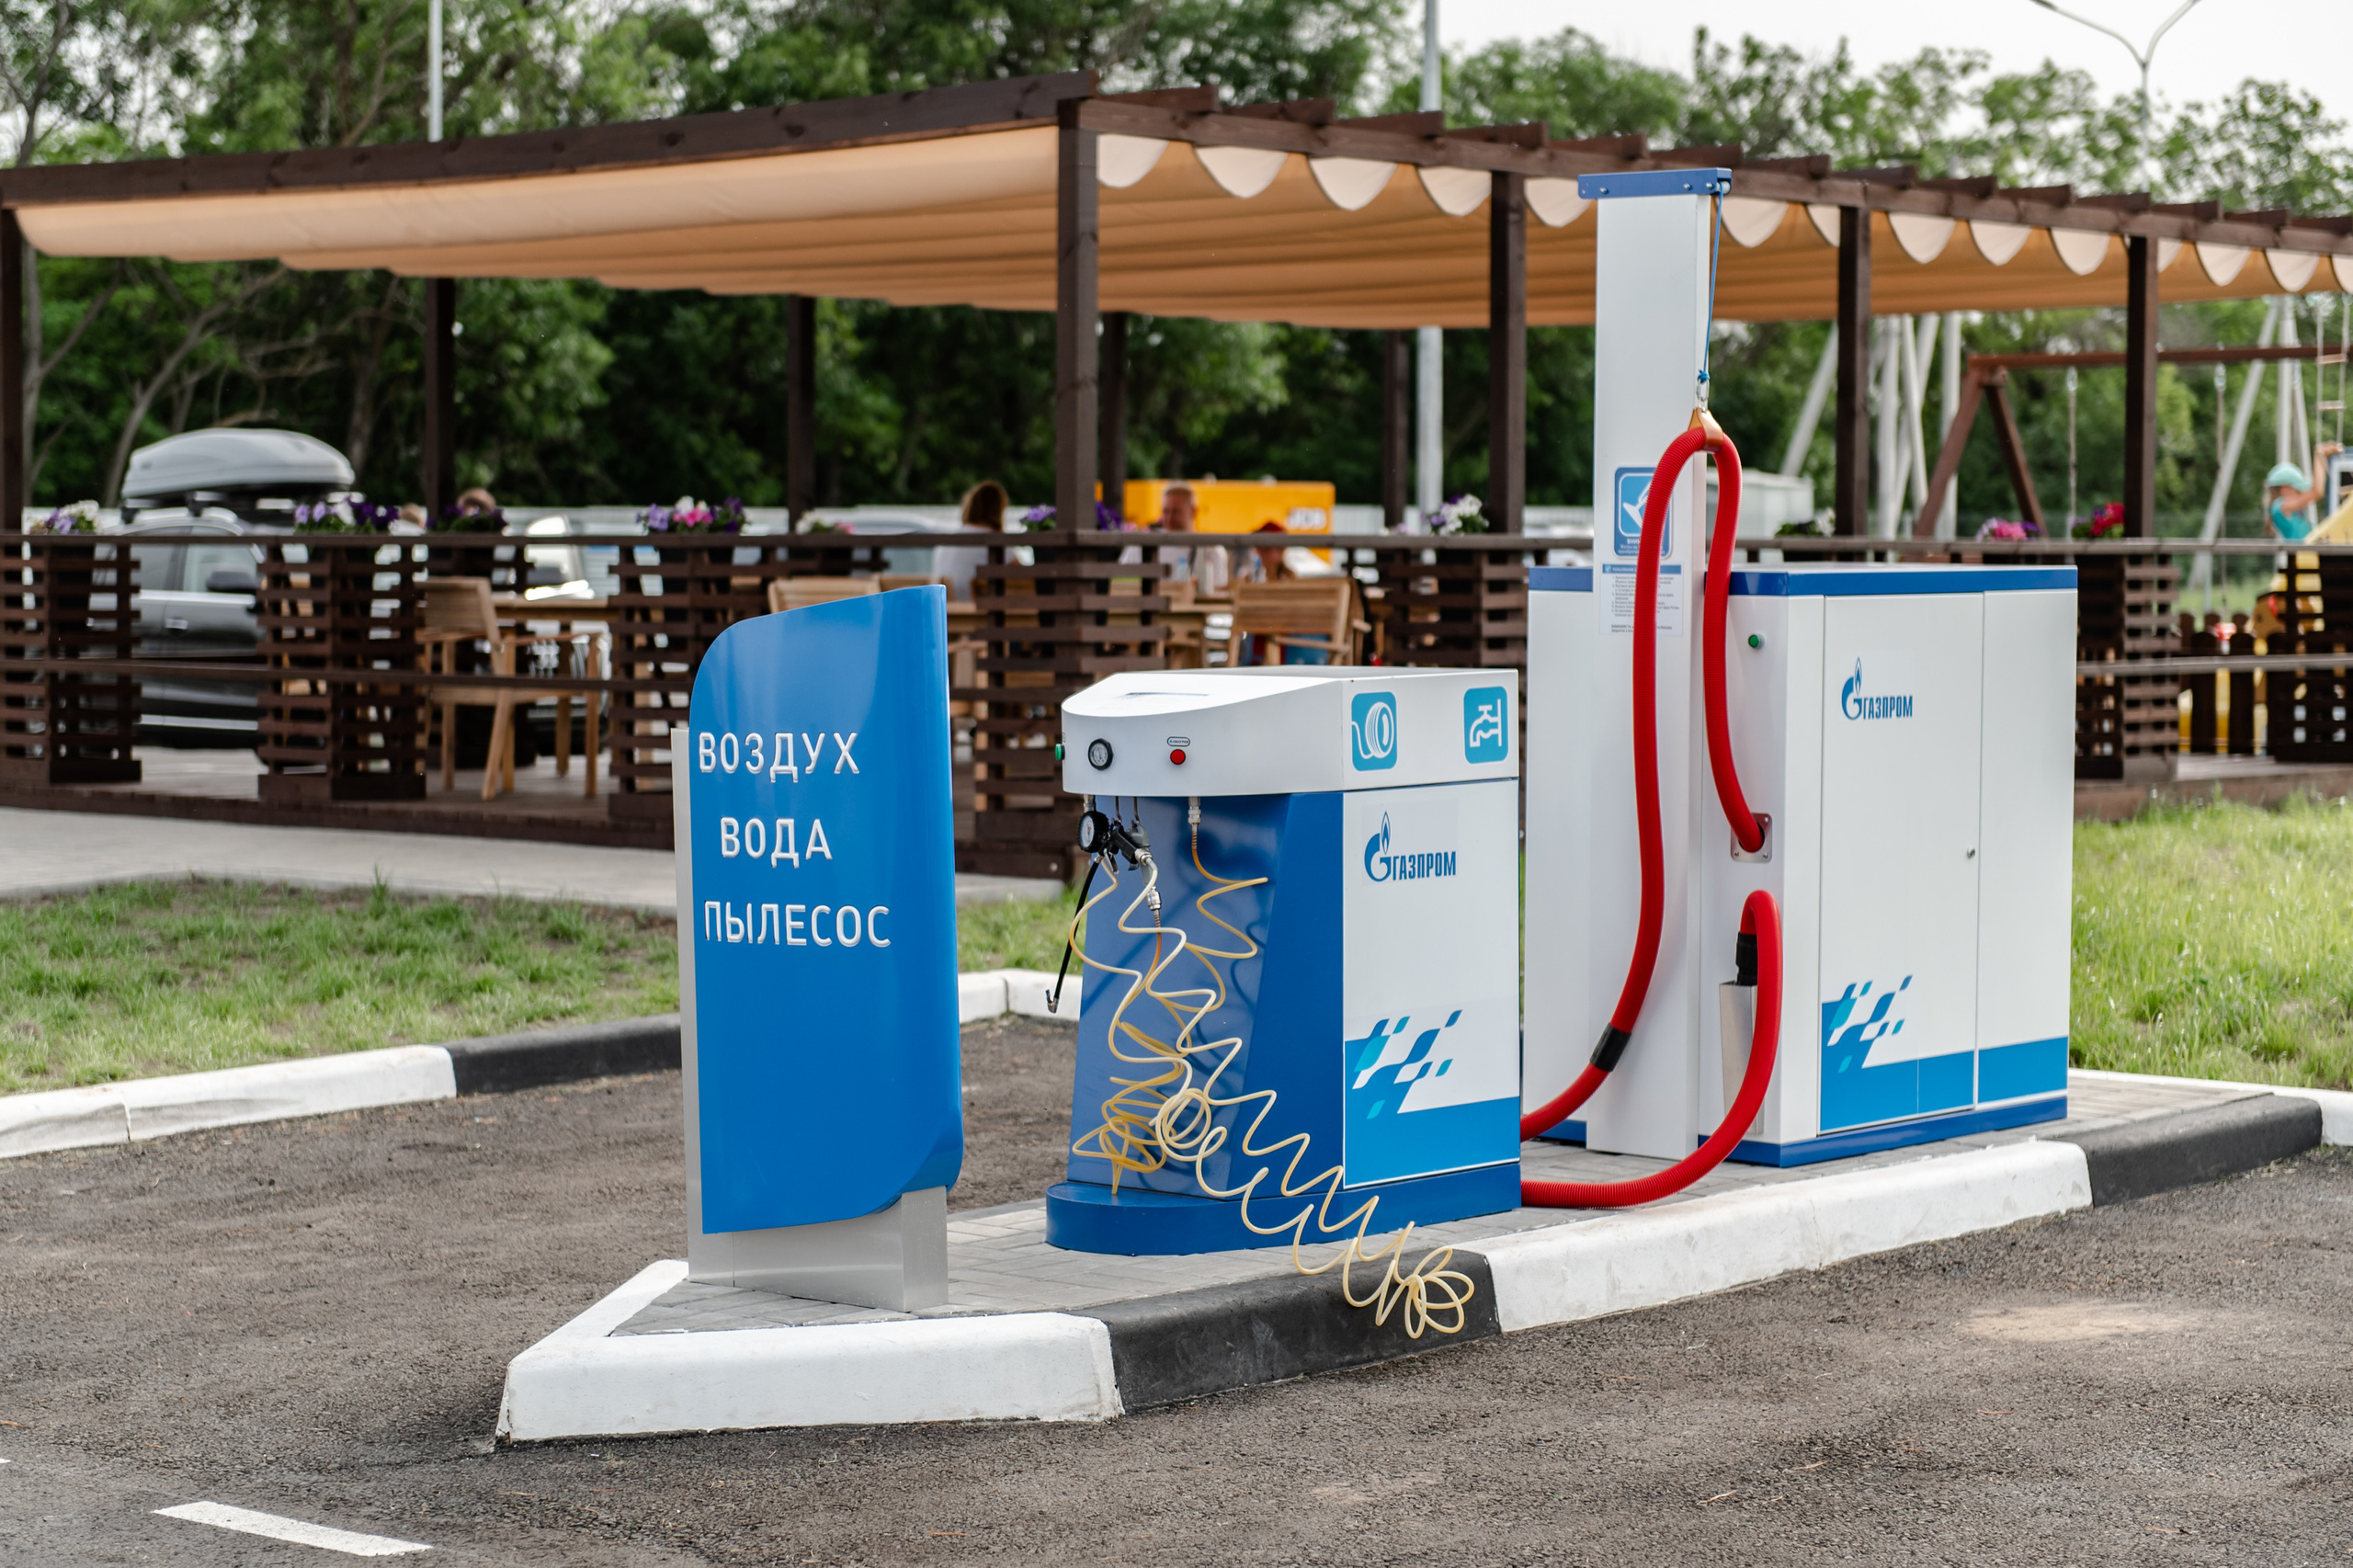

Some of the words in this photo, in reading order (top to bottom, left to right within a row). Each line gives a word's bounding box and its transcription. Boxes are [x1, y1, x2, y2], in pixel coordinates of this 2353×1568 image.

[1863, 695, 1913, 721] ГАЗПРОМ
[699, 732, 860, 783] ВОЗДУХ
[721, 816, 833, 869] ВОДА
[1392, 851, 1456, 881] ГАЗПРОМ
[704, 900, 892, 948] ПЫЛЕСОС
